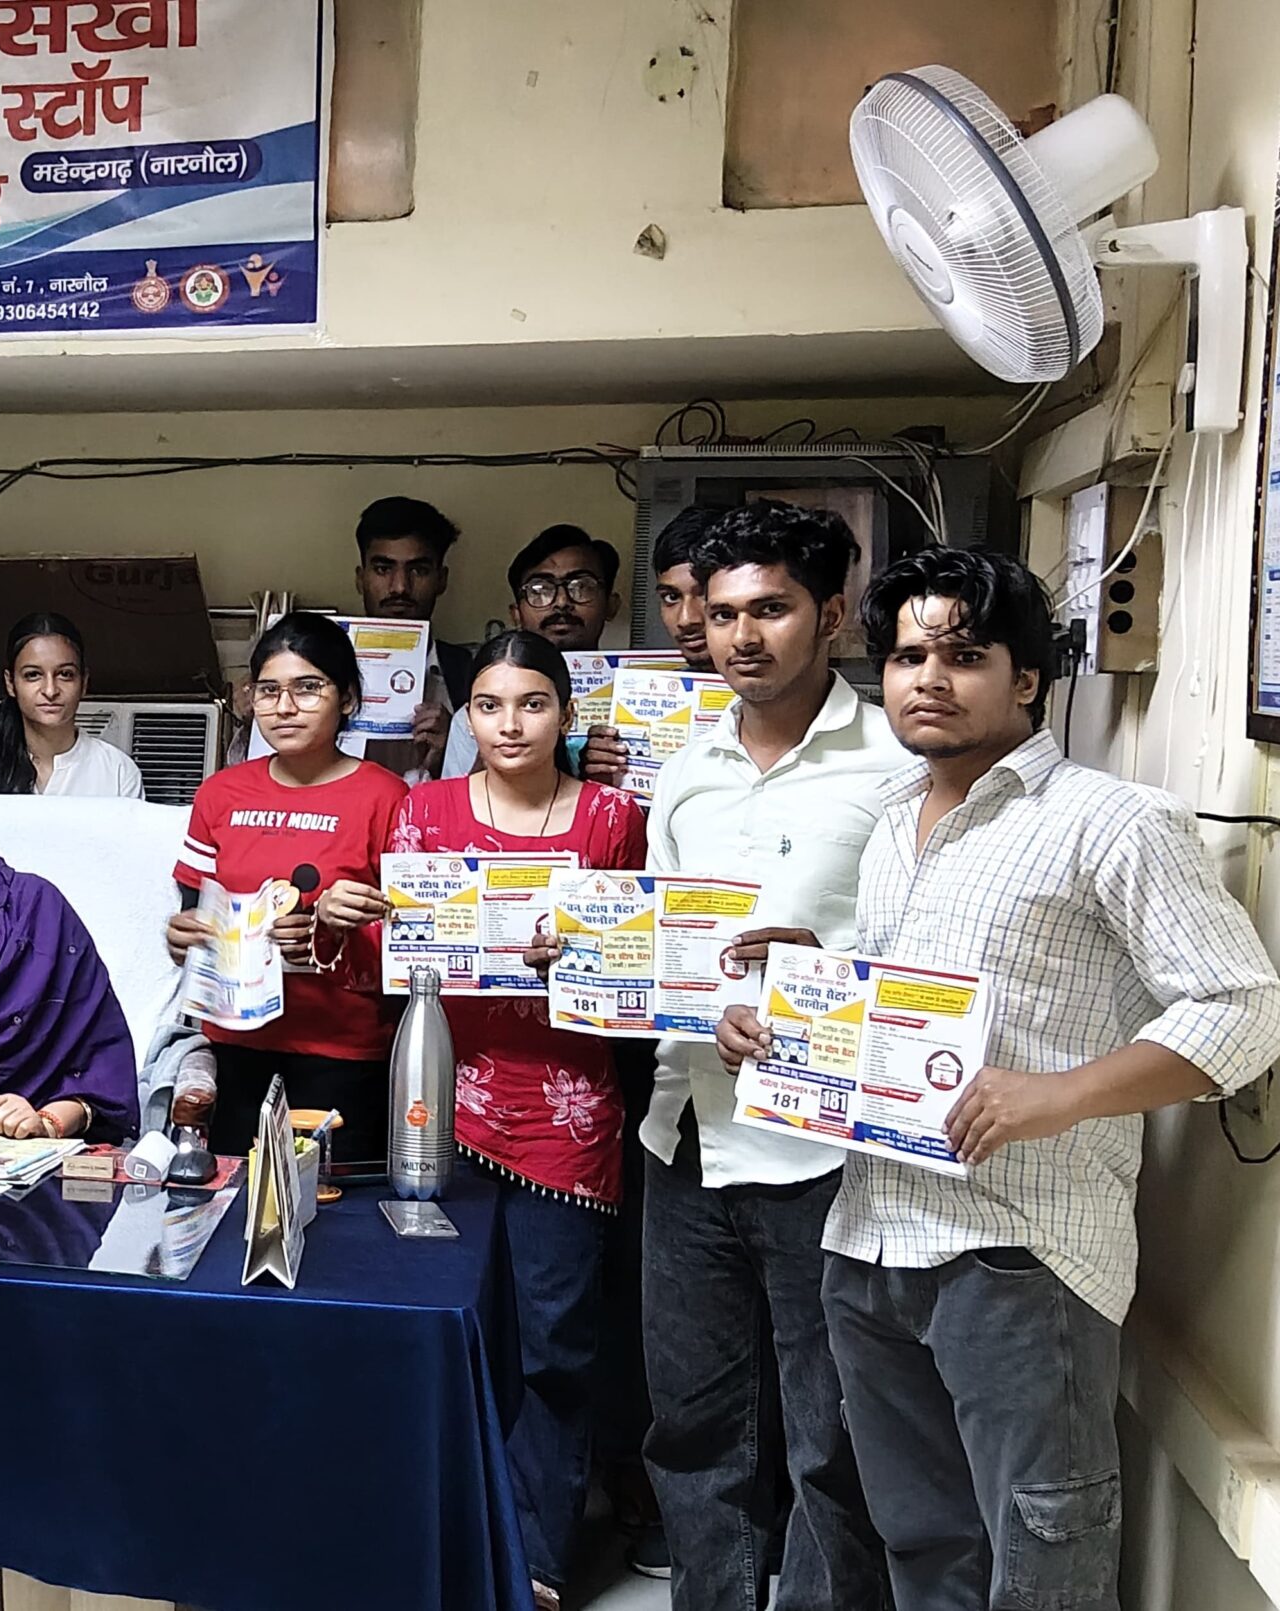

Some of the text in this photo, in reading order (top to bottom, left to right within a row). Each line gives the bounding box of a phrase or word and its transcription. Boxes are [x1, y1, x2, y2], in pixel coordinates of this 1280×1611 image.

[1, 59, 149, 142] स्टॉप
[33, 144, 247, 185] महेन्द्रगढ़ (नारनौल)
[49, 272, 109, 293] नारनौल
[632, 777, 651, 789] 181
[230, 810, 339, 832] MICKEY MOUSE
[449, 956, 472, 970] 181
[573, 998, 597, 1012] 181
[620, 991, 645, 1008] 181
[772, 1092, 800, 1110] 181
[823, 1090, 846, 1112] 181
[401, 1161, 435, 1172] MILTON
